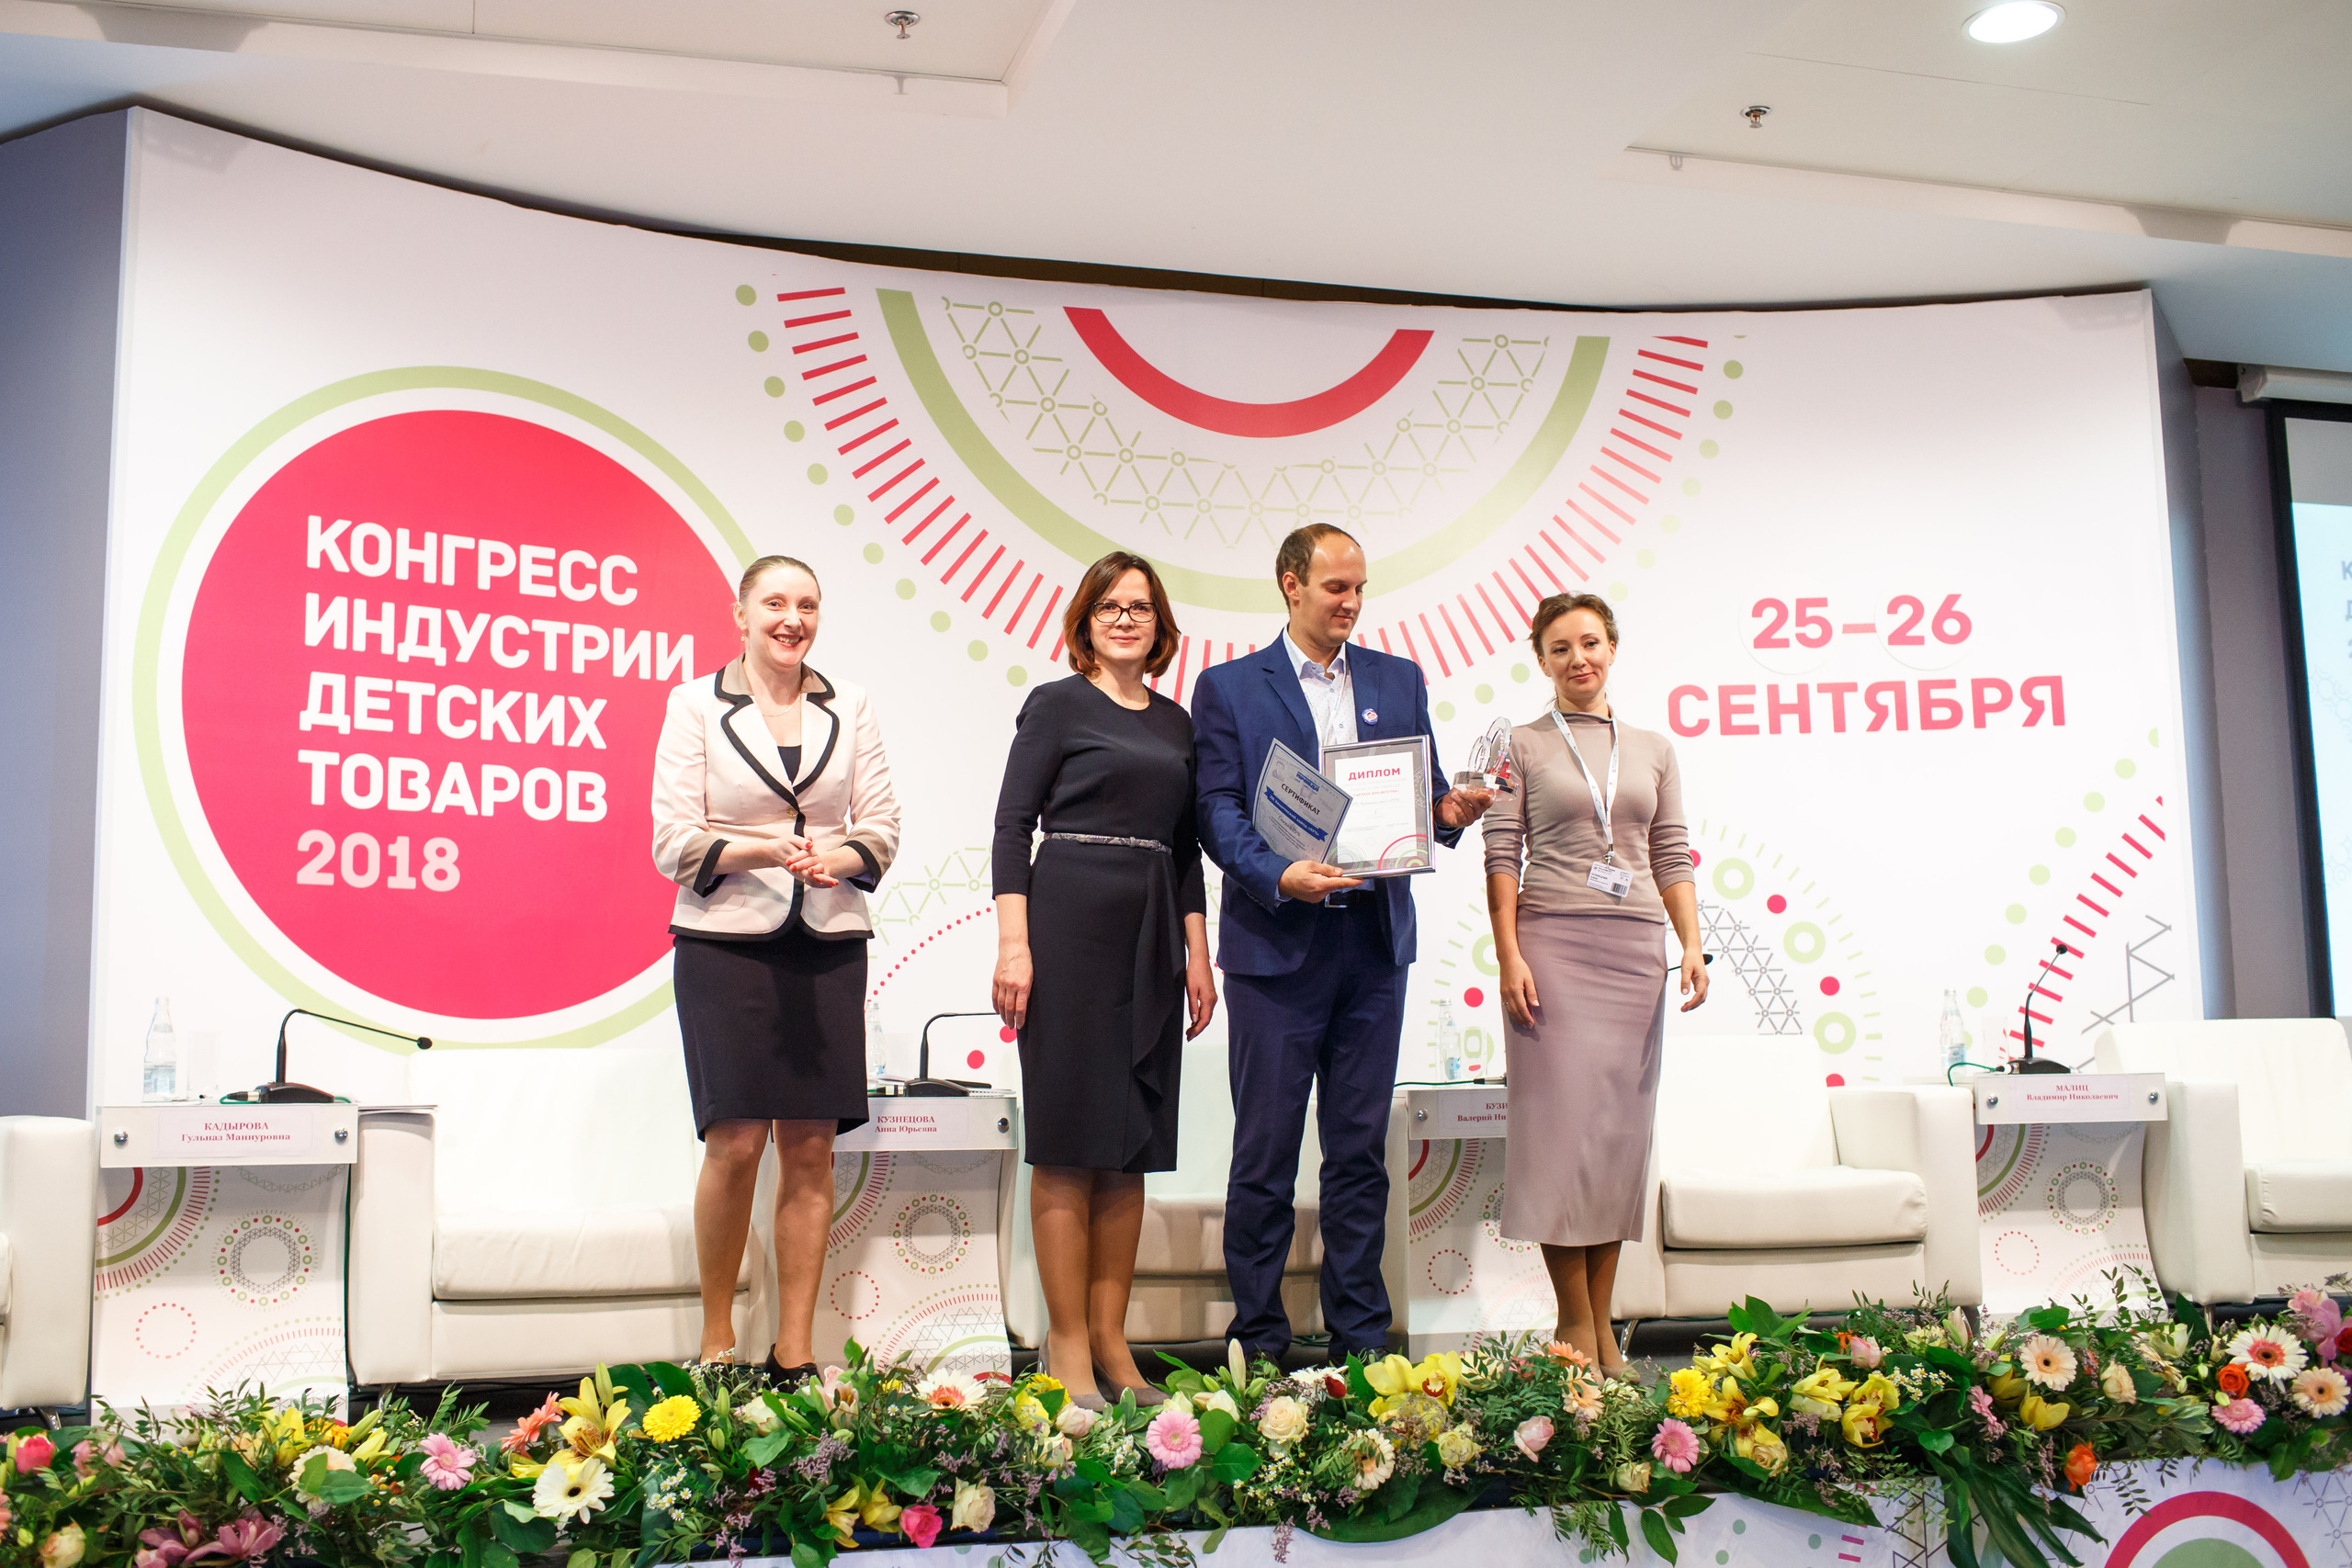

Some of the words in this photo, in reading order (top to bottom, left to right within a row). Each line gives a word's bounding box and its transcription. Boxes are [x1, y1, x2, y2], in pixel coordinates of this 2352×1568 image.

[306, 514, 639, 606] КОНГРЕСС
[304, 592, 695, 682] ИНДУСТРИИ
[299, 671, 607, 750] ДЕТСКИХ
[1667, 675, 2065, 738] СЕНТЯБРЯ
[298, 749, 607, 823] ТОВАРОВ
[1348, 768, 1400, 781] ДИПЛОМ
[1281, 783, 1321, 816] СЕРТИФИКАТ
[296, 829, 461, 892] 2018
[2026, 1093, 2067, 1101] Владимир
[204, 1122, 269, 1131] КАДЫРОВА
[877, 1115, 935, 1123] КУЗНЕЦОВА
[899, 1125, 937, 1134] Юрьевна
[1457, 1114, 1492, 1122] Валерий
[182, 1134, 223, 1143] Гульназ
